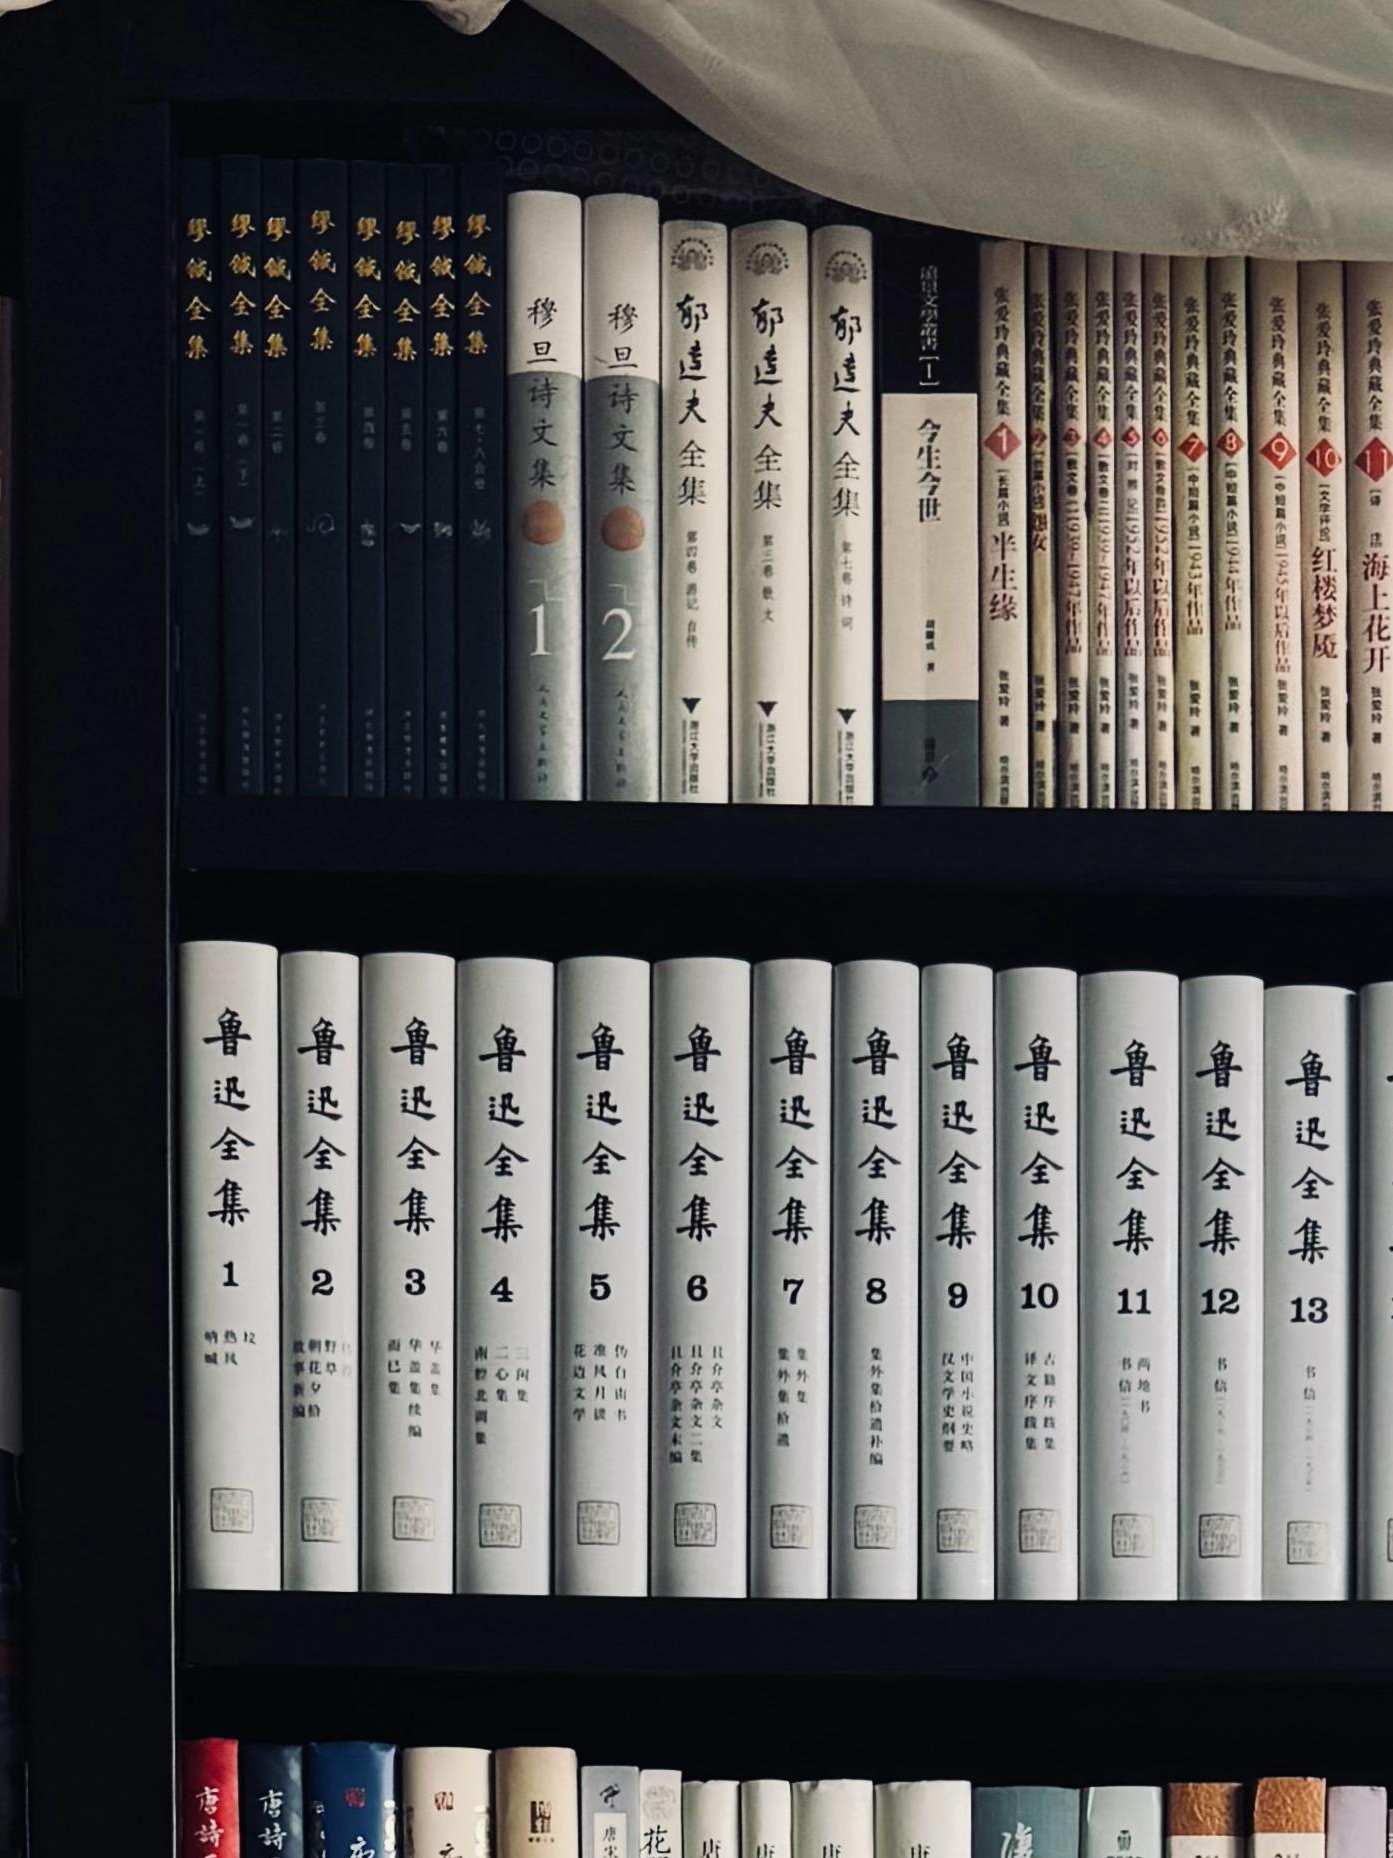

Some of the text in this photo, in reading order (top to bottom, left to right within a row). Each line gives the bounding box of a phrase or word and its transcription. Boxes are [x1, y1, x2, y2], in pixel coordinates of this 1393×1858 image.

[527, 296, 559, 489] 穆旦诗文集
[608, 296, 639, 494] 穆旦诗文集
[992, 286, 1011, 417] 张爱玲典藏全集
[916, 418, 942, 523] 今生今世
[529, 603, 553, 657] 1
[990, 531, 1018, 621] 半生缘
[1311, 546, 1338, 659] 红楼梦魇
[1362, 552, 1390, 674] 海上花开
[601, 607, 636, 661] 2
[202, 1006, 256, 1229] 鲁迅全集
[478, 1023, 530, 1243] 鲁迅全集
[673, 1023, 724, 1243] 鲁迅全集
[851, 1026, 902, 1247] 鲁迅全集
[1013, 1032, 1064, 1250] 鲁迅全集
[221, 1261, 239, 1287] 1
[489, 1277, 514, 1303] 4
[686, 1276, 709, 1302] 6
[865, 1278, 887, 1304] 8
[1019, 1282, 1059, 1310] 10
